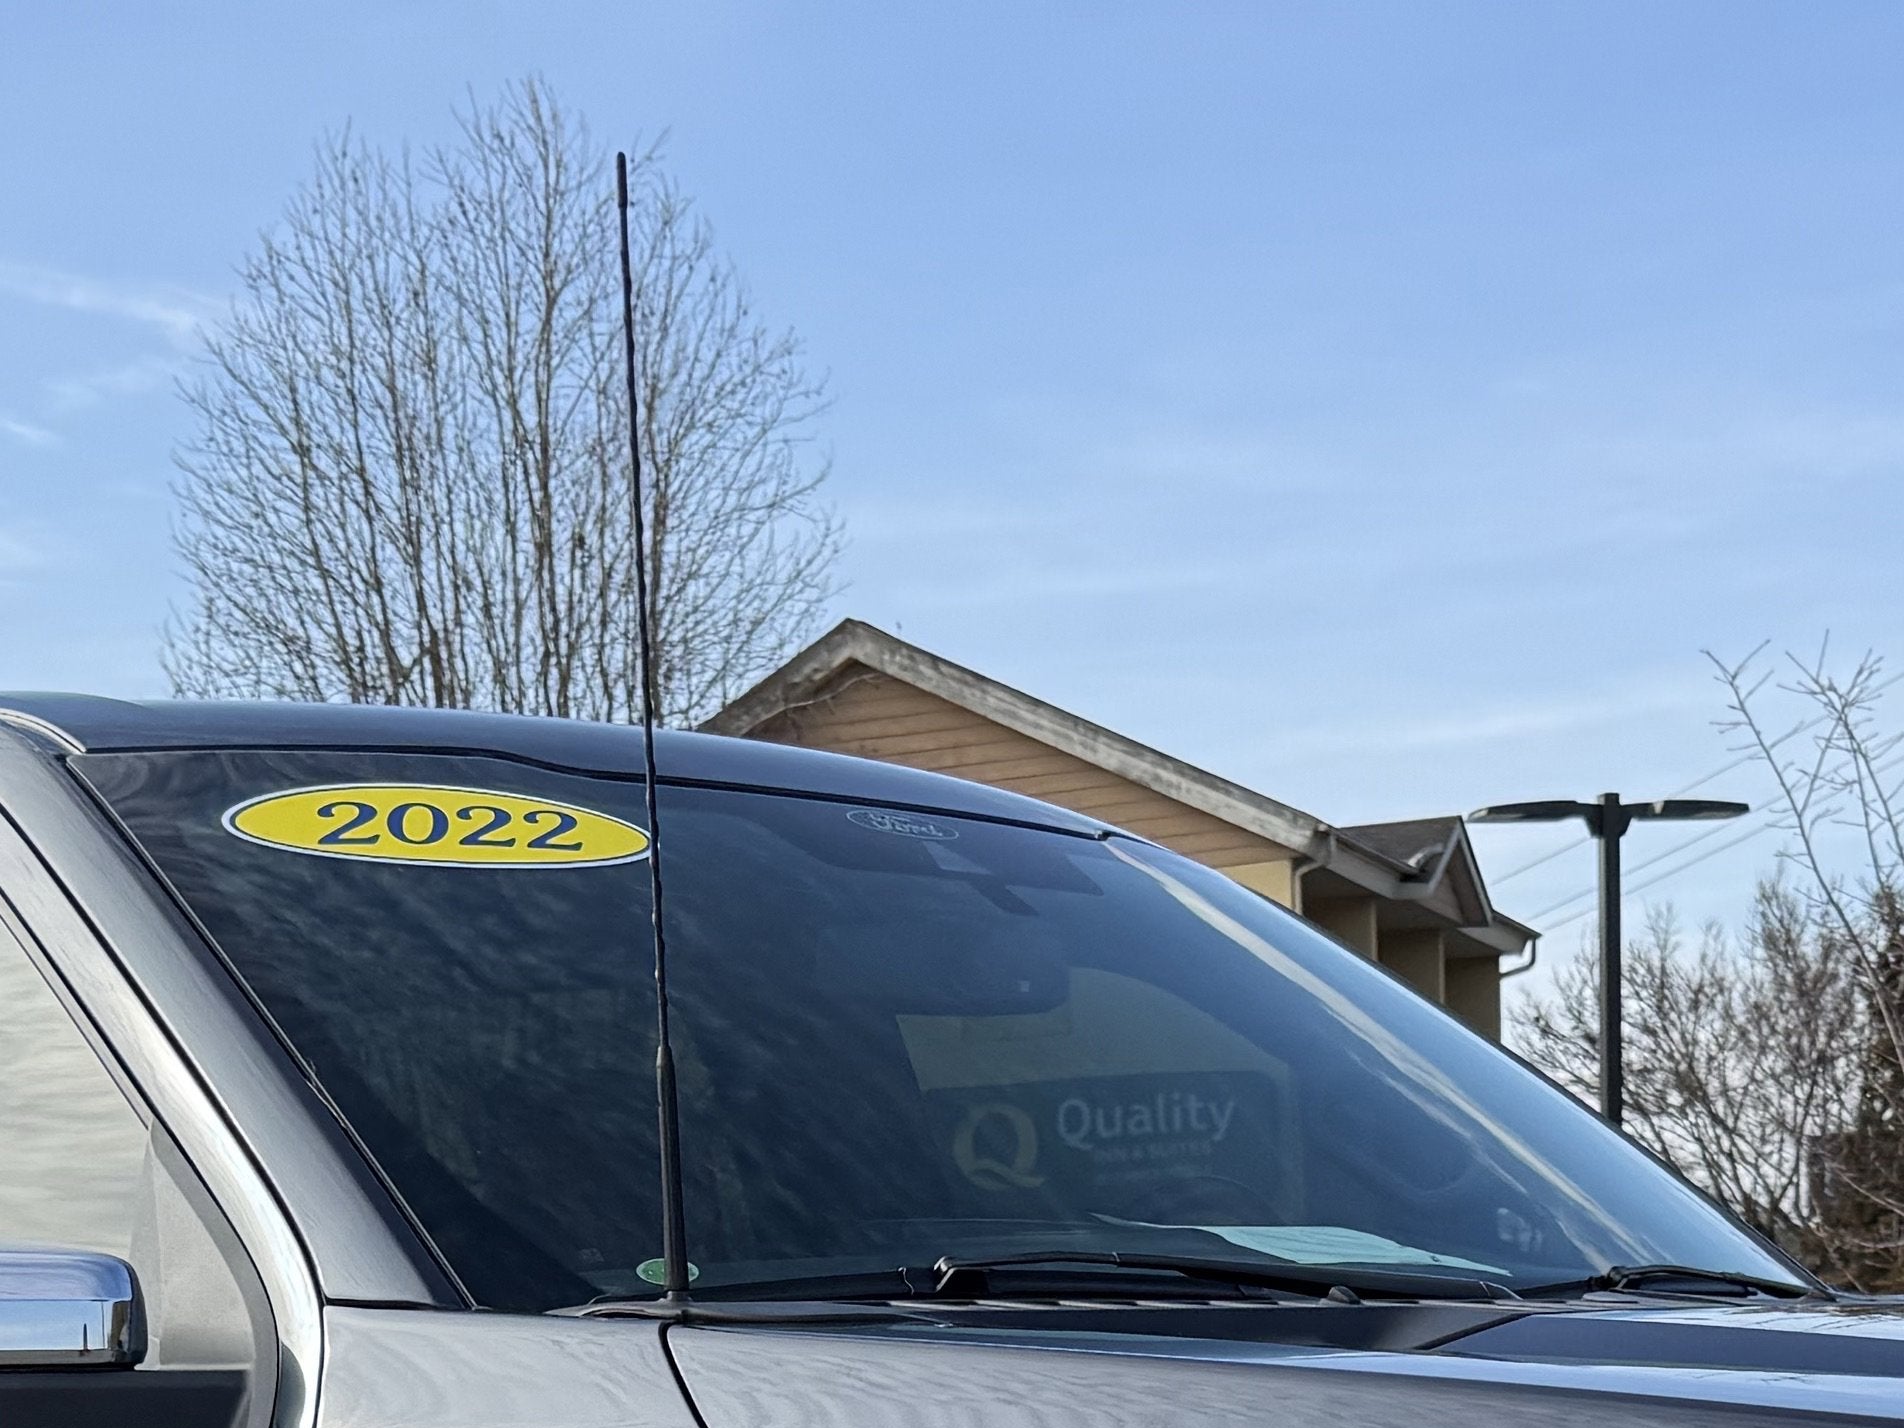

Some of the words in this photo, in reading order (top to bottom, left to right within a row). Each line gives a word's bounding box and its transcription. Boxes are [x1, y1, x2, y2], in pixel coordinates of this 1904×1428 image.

[316, 801, 583, 852] 2022
[952, 1102, 1046, 1191] Q
[1057, 1092, 1236, 1151] Quality
